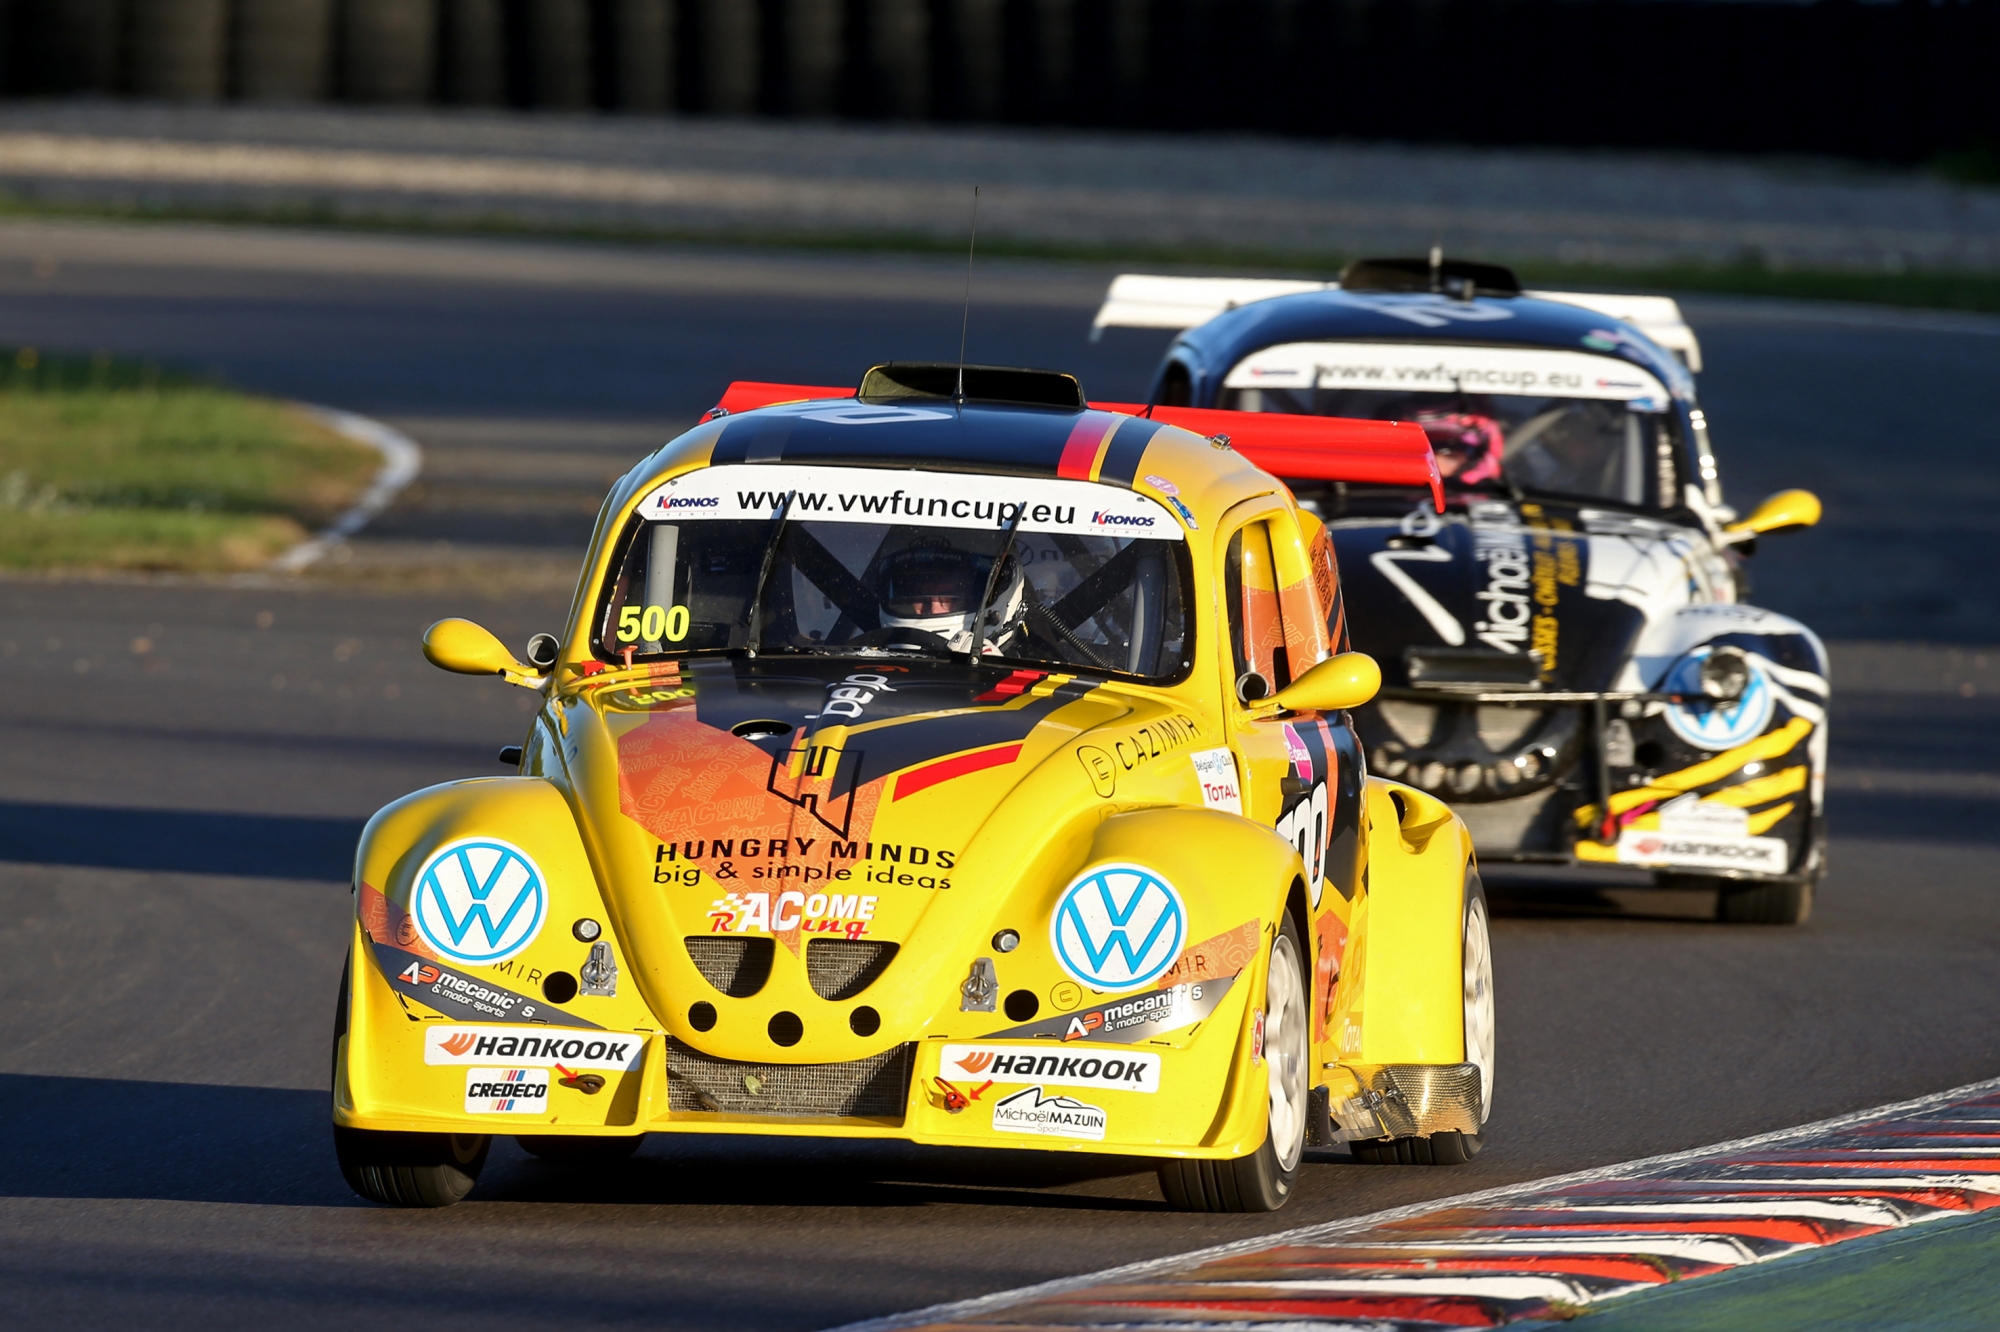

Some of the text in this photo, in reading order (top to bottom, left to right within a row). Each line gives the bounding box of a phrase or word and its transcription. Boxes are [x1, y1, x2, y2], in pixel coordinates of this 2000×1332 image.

[656, 491, 720, 509] KRONOS
[736, 490, 1076, 527] www.vwfuncup.eu
[1091, 508, 1156, 526] KRONOS
[616, 604, 690, 643] 500
[1115, 713, 1202, 771] CAZIMIR
[1203, 783, 1238, 802] TOTAL
[655, 837, 956, 869] HUNGRY MINDS
[653, 861, 952, 890] big & simple ideas
[431, 983, 506, 1019] & motor sports
[1104, 1021, 1115, 1033] &
[1116, 1013, 1148, 1030] motor
[467, 1082, 548, 1098] CREDECO
[1036, 1123, 1060, 1133] Sport
[1048, 1111, 1104, 1128] MAZUIN
